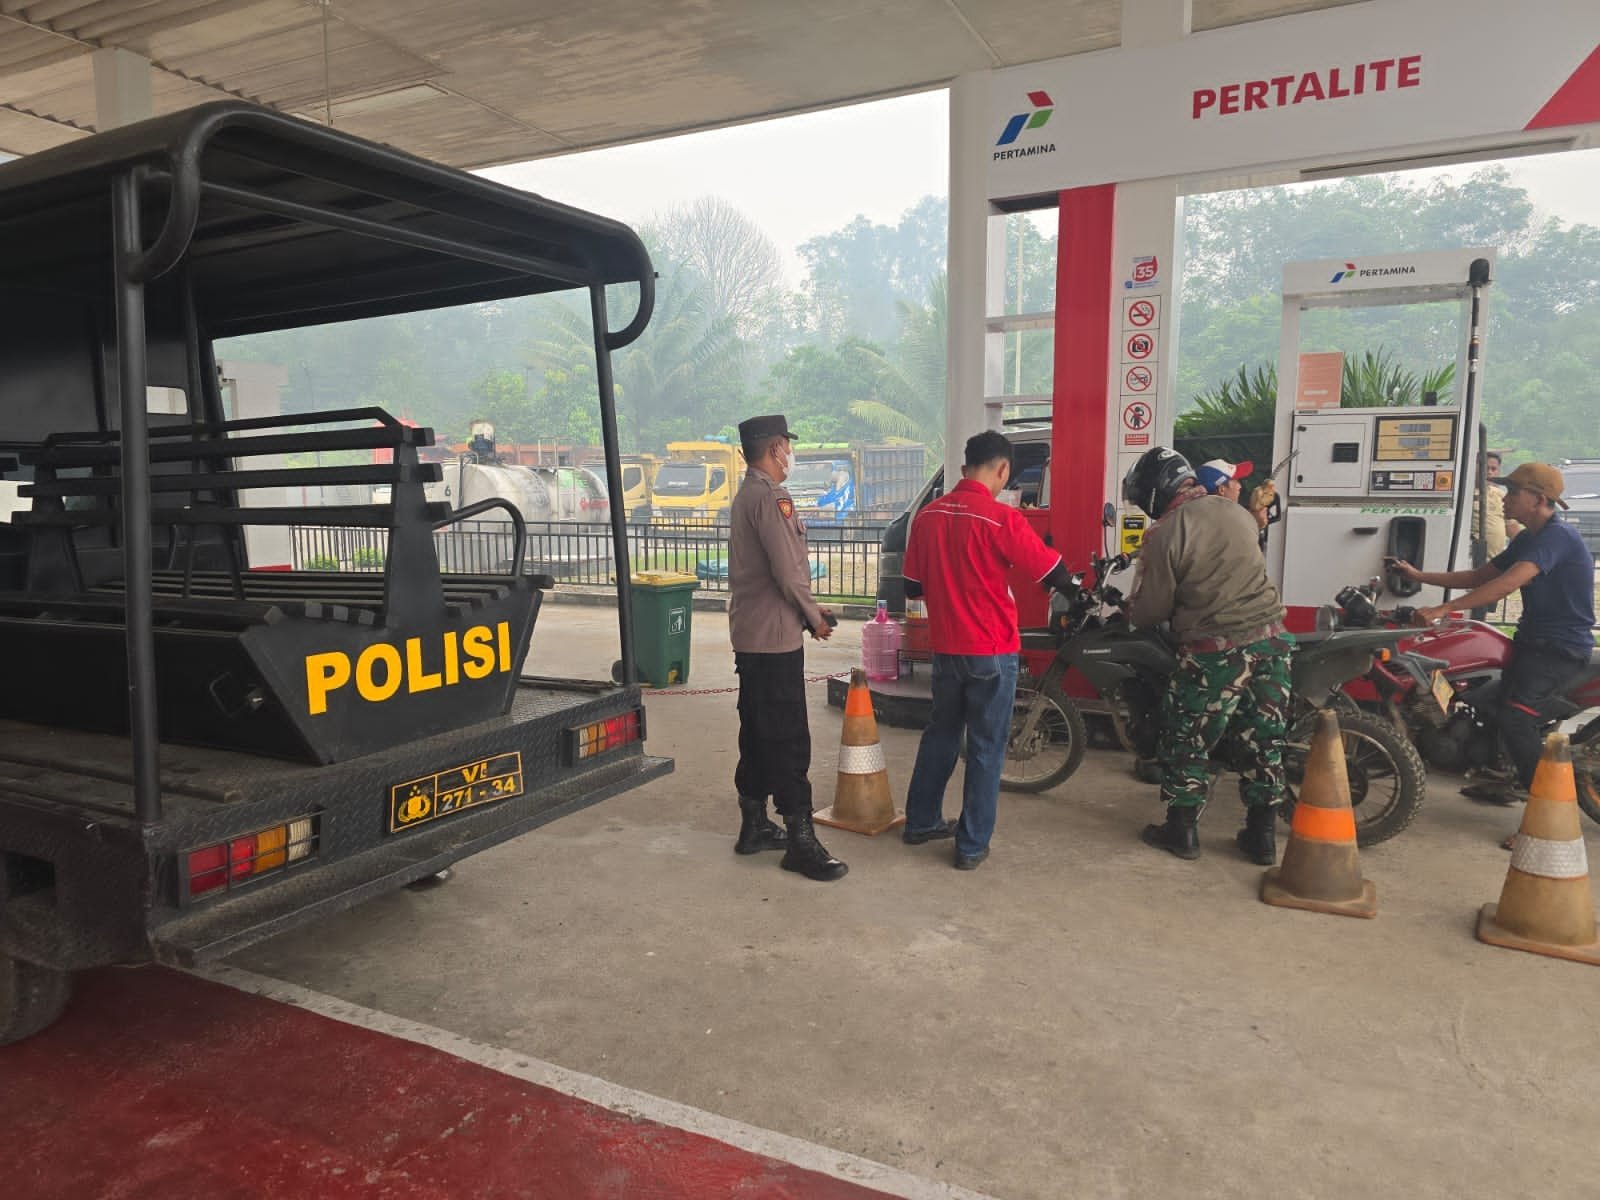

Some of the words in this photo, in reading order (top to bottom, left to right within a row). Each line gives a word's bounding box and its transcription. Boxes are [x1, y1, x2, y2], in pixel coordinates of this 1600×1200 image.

[1191, 54, 1422, 119] PERTALITE
[993, 143, 1056, 161] PERTAMINA
[1359, 265, 1416, 278] PERTAMINA
[1360, 505, 1449, 516] PERTALITE
[305, 620, 511, 716] POLISI
[441, 787, 473, 812] 271
[491, 776, 516, 796] 34
